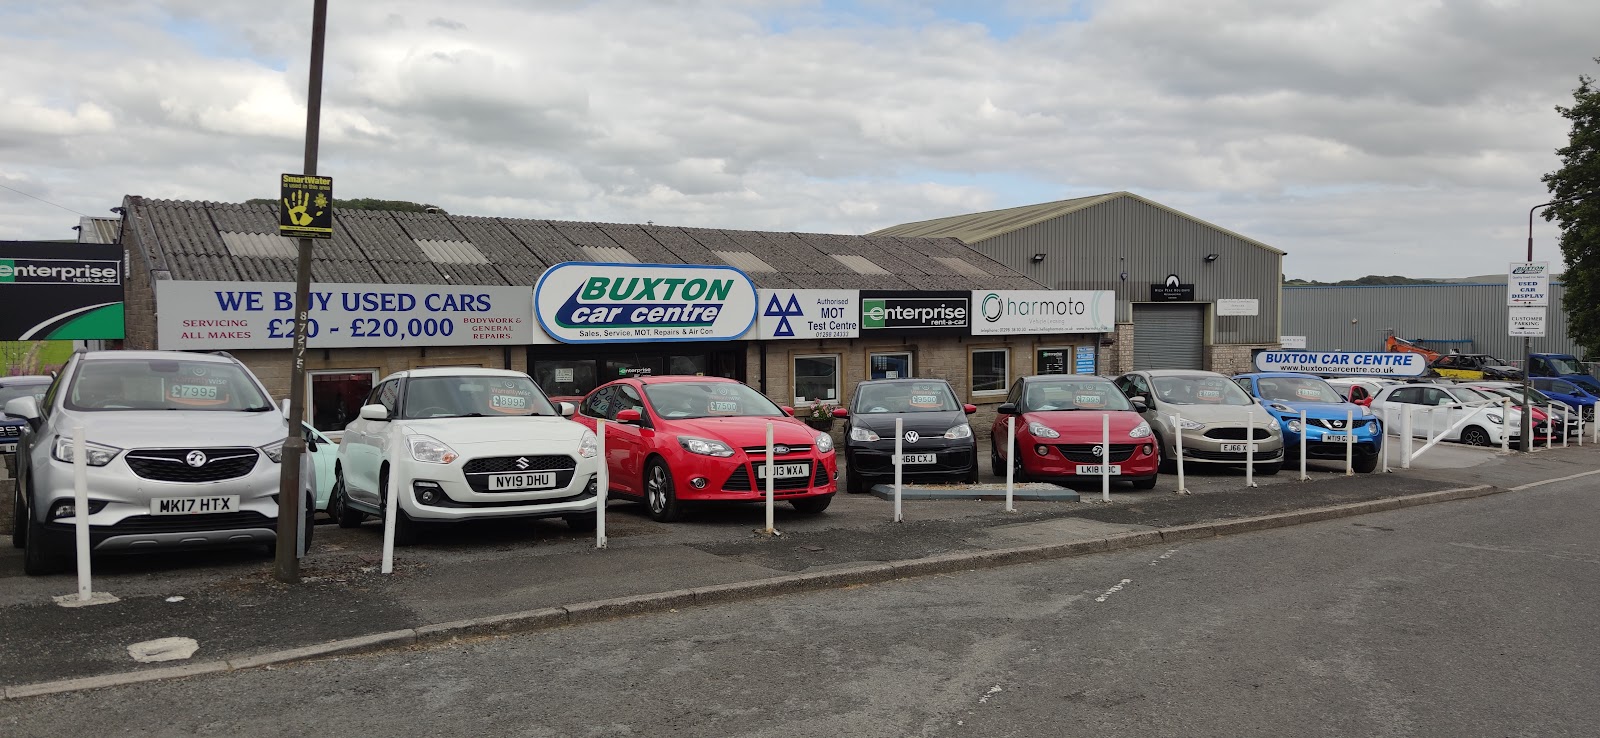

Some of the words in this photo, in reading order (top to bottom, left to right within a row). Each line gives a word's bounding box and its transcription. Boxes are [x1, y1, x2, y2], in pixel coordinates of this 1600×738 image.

[283, 174, 331, 185] SmartWater
[0, 264, 117, 281] enterprise
[581, 277, 735, 301] BUXTON
[214, 291, 264, 312] WE
[341, 292, 417, 312] USED
[424, 293, 492, 312] CARS
[1007, 297, 1086, 316] harmoto
[571, 306, 623, 324] car
[630, 303, 718, 323] centre
[821, 307, 845, 319] MOT
[869, 303, 966, 322] enterprise
[182, 319, 248, 328] SERVICING
[267, 318, 319, 339] £20
[350, 318, 454, 340] £20,000
[808, 320, 826, 331] Test
[829, 320, 857, 331] Centre
[181, 331, 205, 339] ALL
[207, 331, 252, 339] MAKES
[579, 329, 602, 338] Sales,
[603, 329, 633, 338] Service,
[653, 328, 680, 337] Repairs
[700, 327, 714, 335] Con
[1266, 353, 1318, 364] BUXTON
[1321, 354, 1350, 365] CAR
[1353, 354, 1414, 366] CENTRE
[1280, 364, 1395, 374] www.buxtoncarcentre.co.uk
[171, 385, 216, 398] £7995
[917, 454, 933, 463] CXJ
[786, 465, 804, 476] WXA
[1081, 465, 1099, 474] LK18
[496, 476, 523, 488] NY19
[526, 474, 549, 486] DHU
[160, 499, 196, 513] MK17
[200, 497, 230, 511] HTX
